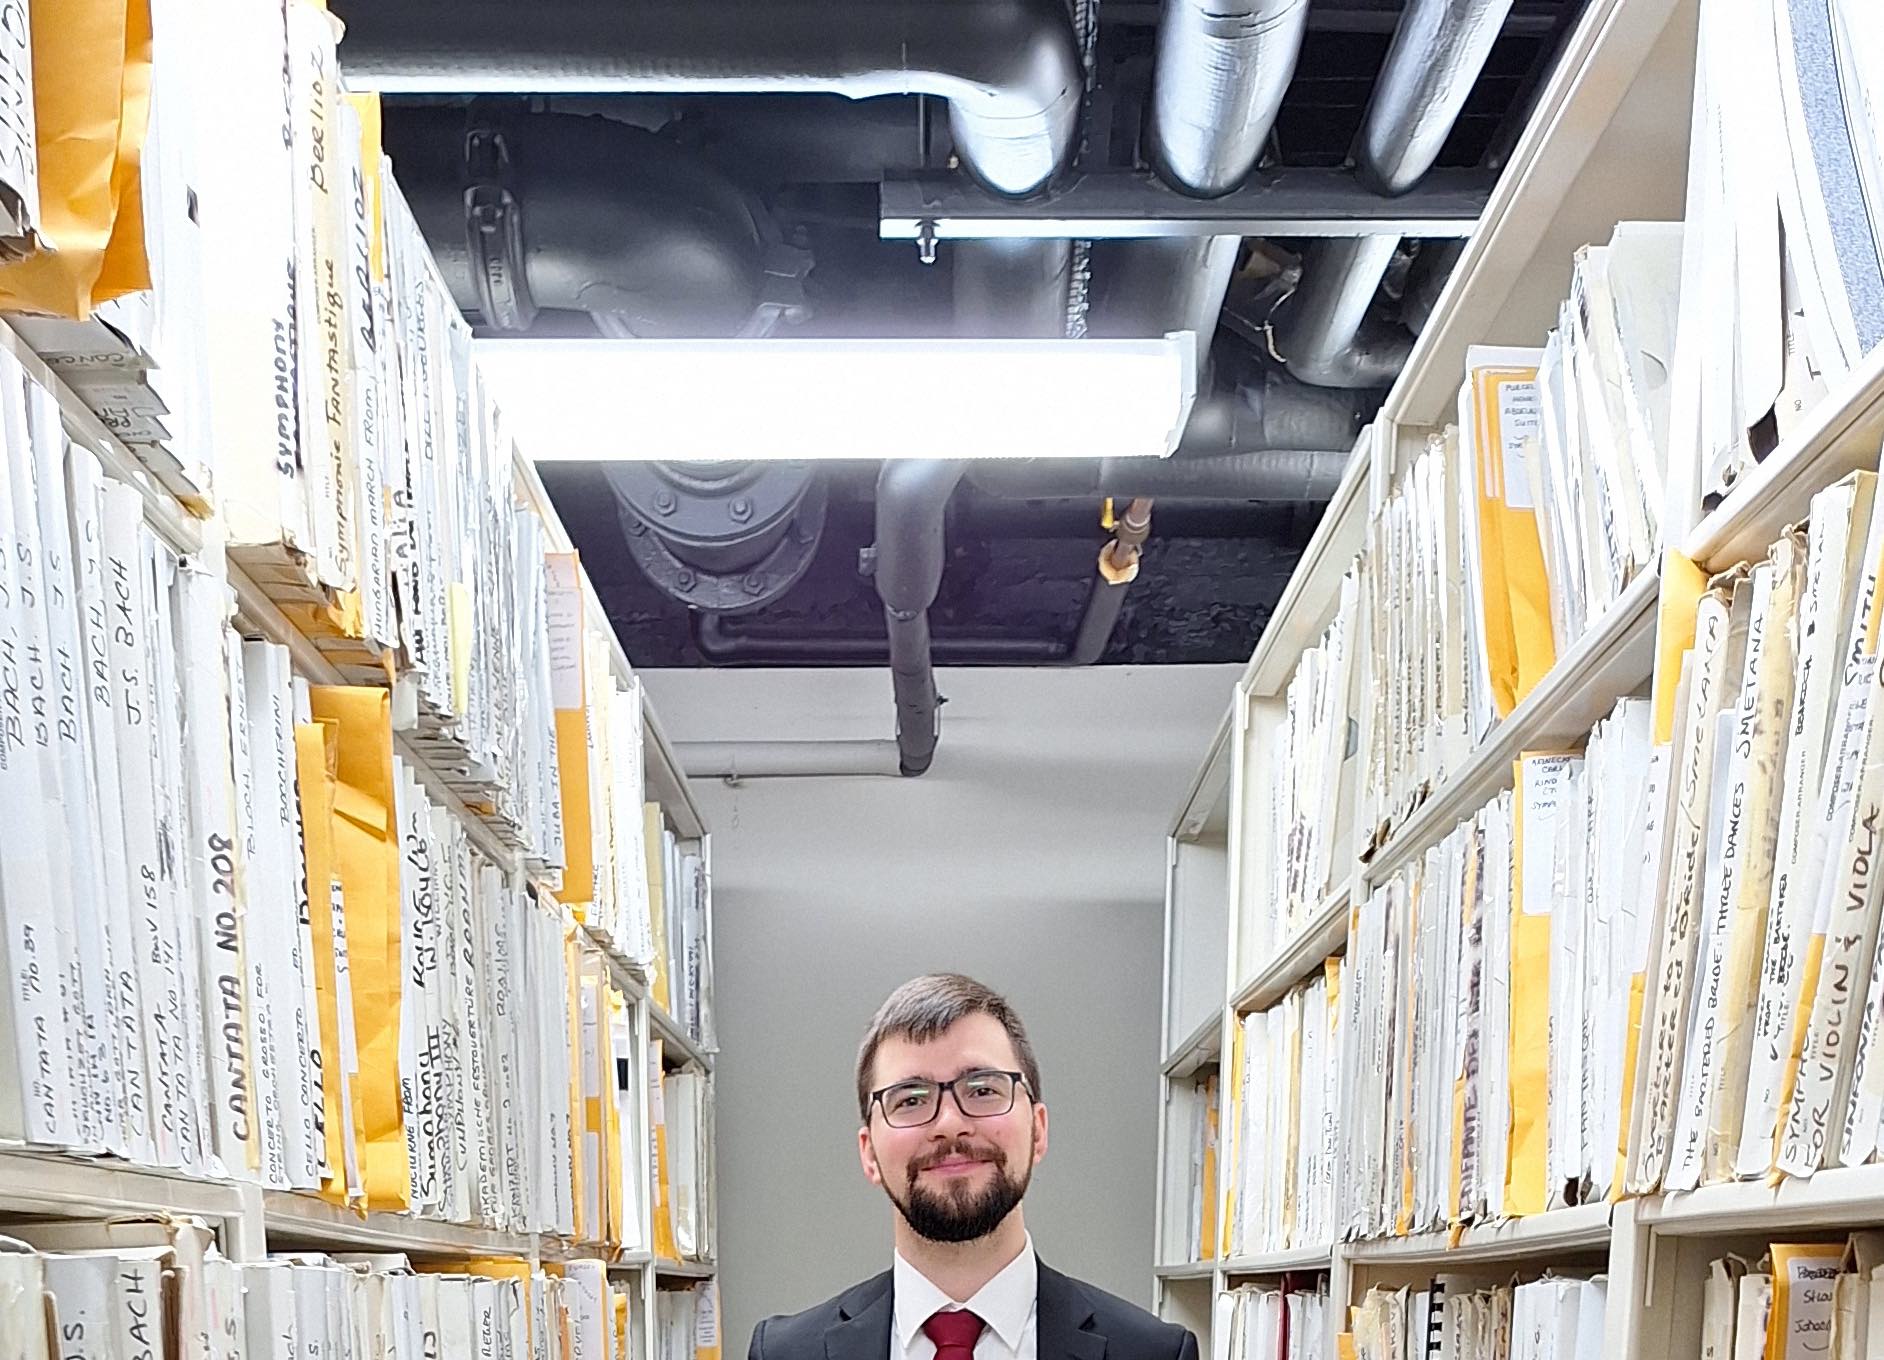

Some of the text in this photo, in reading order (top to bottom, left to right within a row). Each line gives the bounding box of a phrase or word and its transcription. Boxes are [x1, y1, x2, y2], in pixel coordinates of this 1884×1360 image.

[109, 557, 134, 648] BACH
[1721, 780, 1746, 858] DANCES
[1734, 612, 1764, 759] SMETANA
[142, 865, 157, 910] 158
[119, 972, 146, 1137] CANTATA
[208, 833, 250, 1142] CANTATA NO. 208
[1803, 803, 1879, 1168] FOR VIOLIN VIOLA
[1842, 1000, 1874, 1156] SINFONIA
